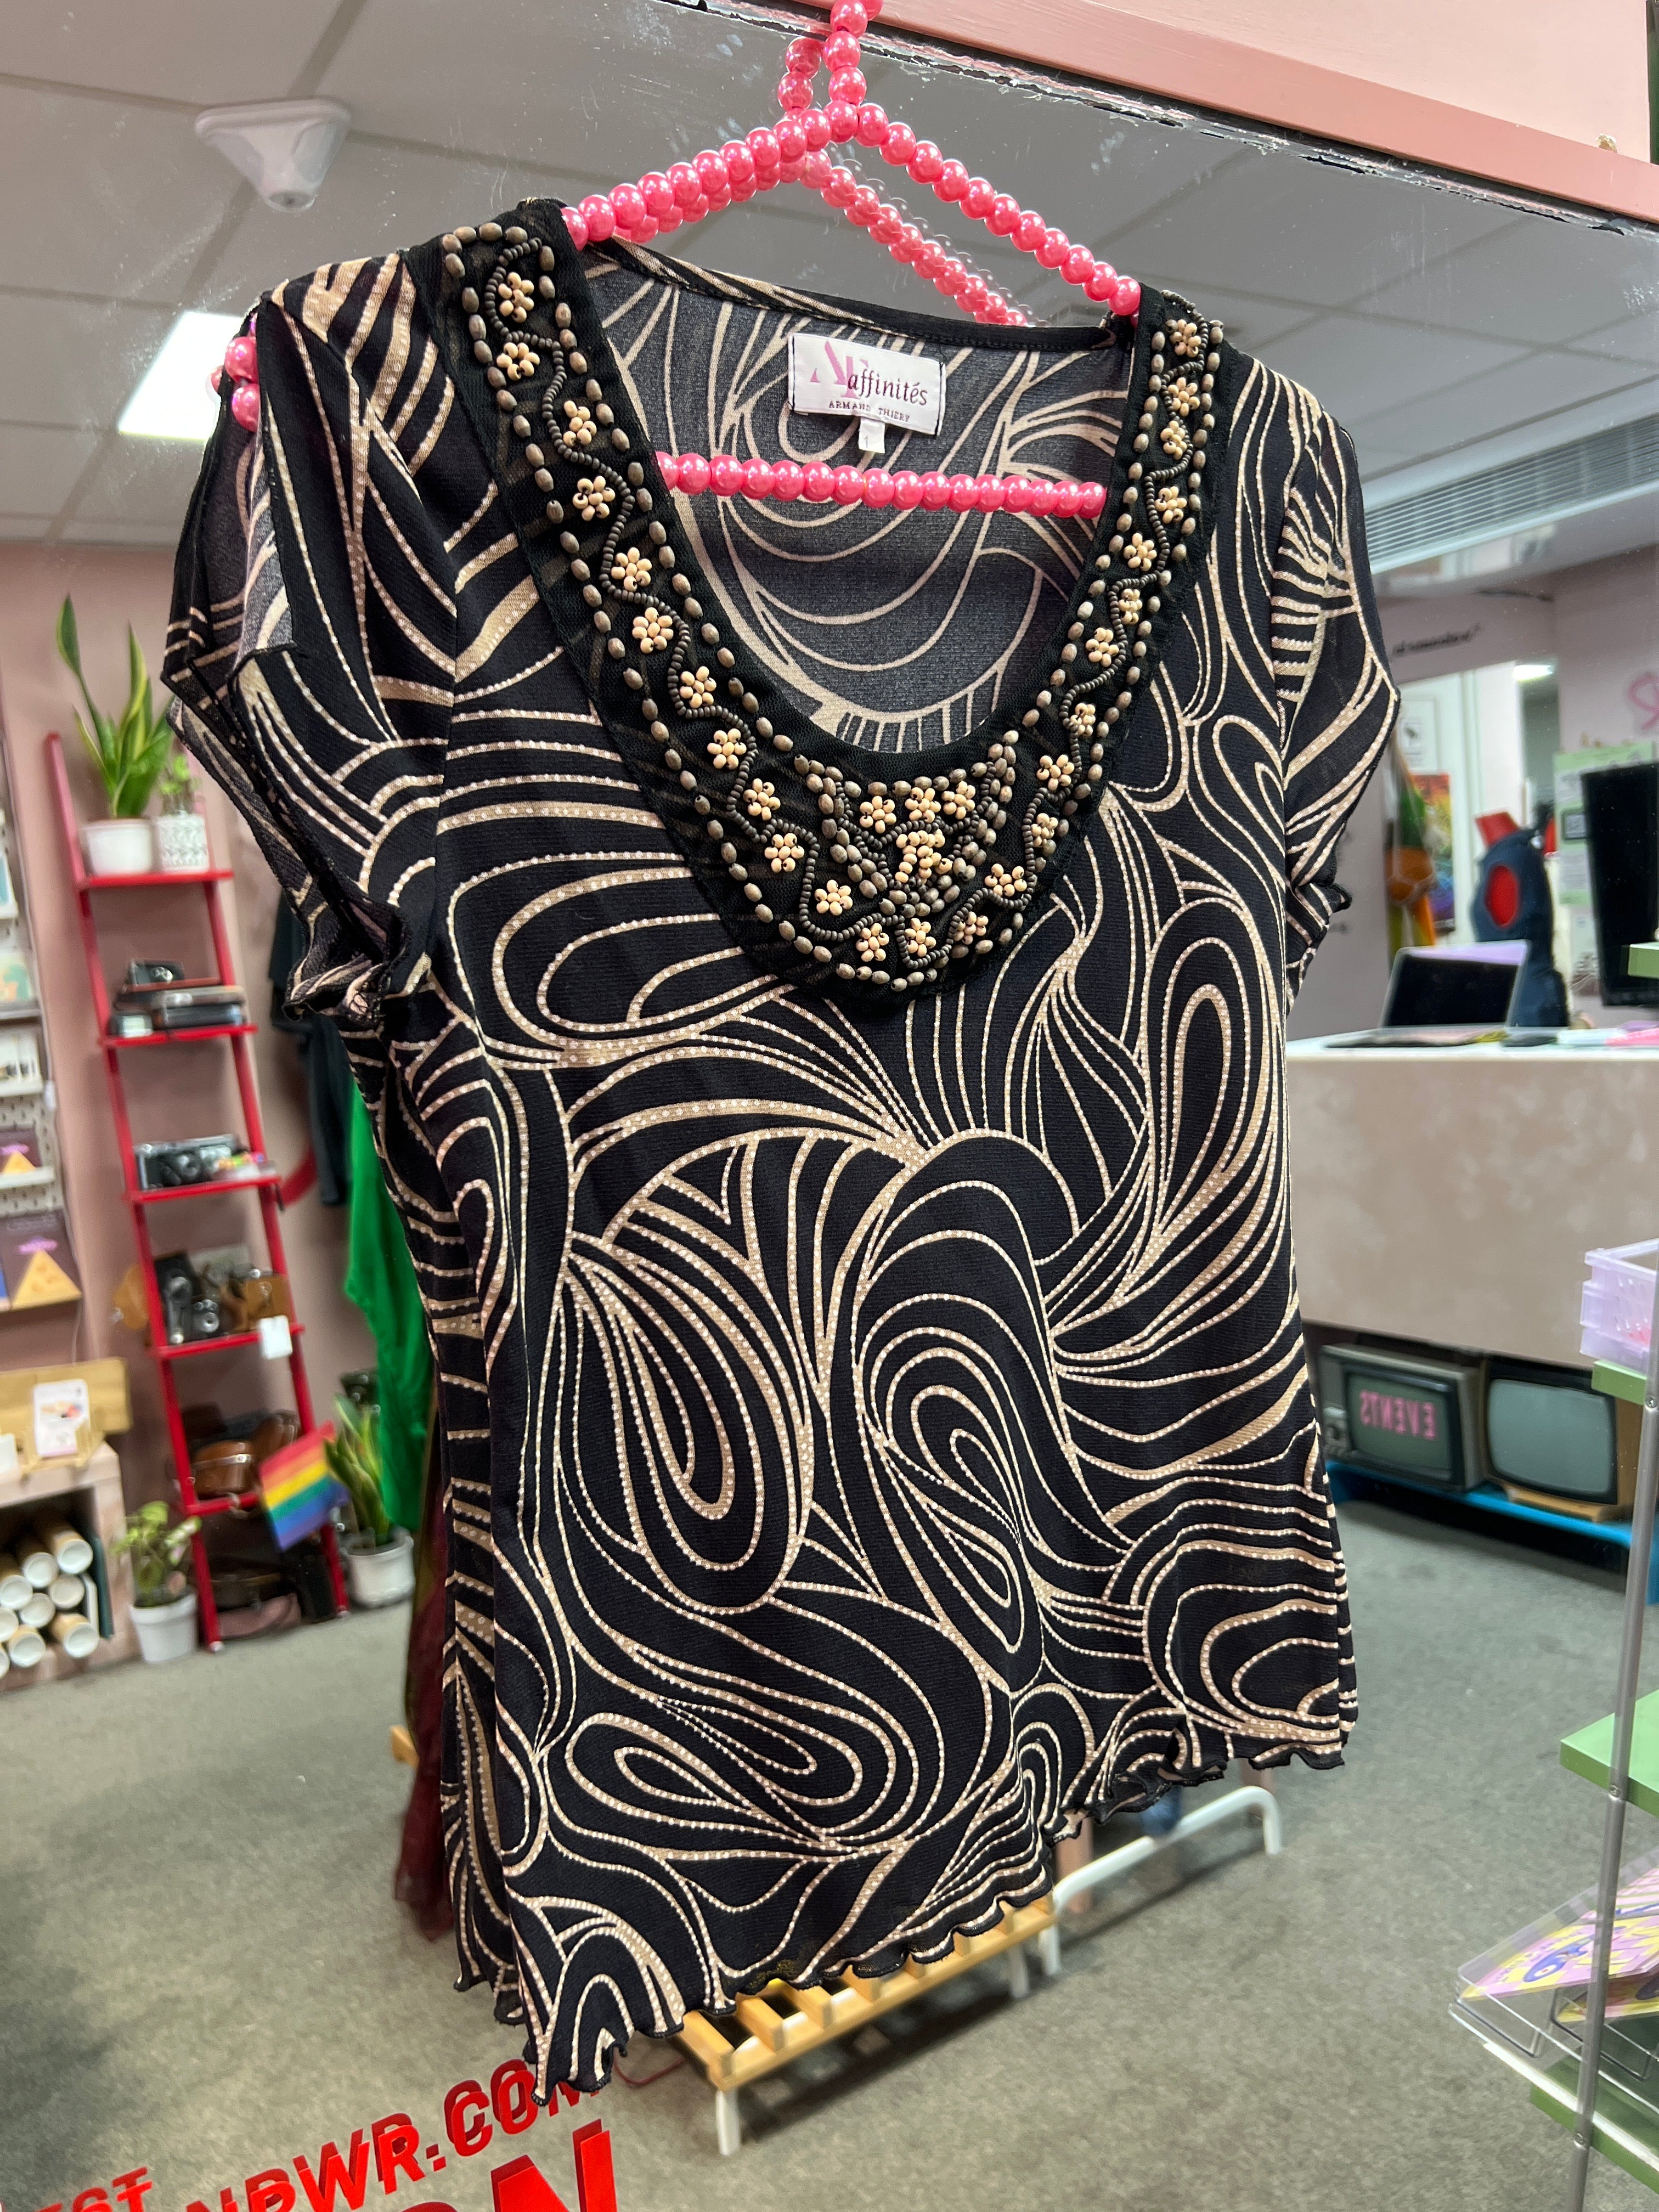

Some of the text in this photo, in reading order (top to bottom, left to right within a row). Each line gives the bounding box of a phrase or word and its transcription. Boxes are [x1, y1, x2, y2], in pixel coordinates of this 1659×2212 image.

[848, 368, 928, 406] affinités
[829, 401, 911, 422] ARMAND THIERY
